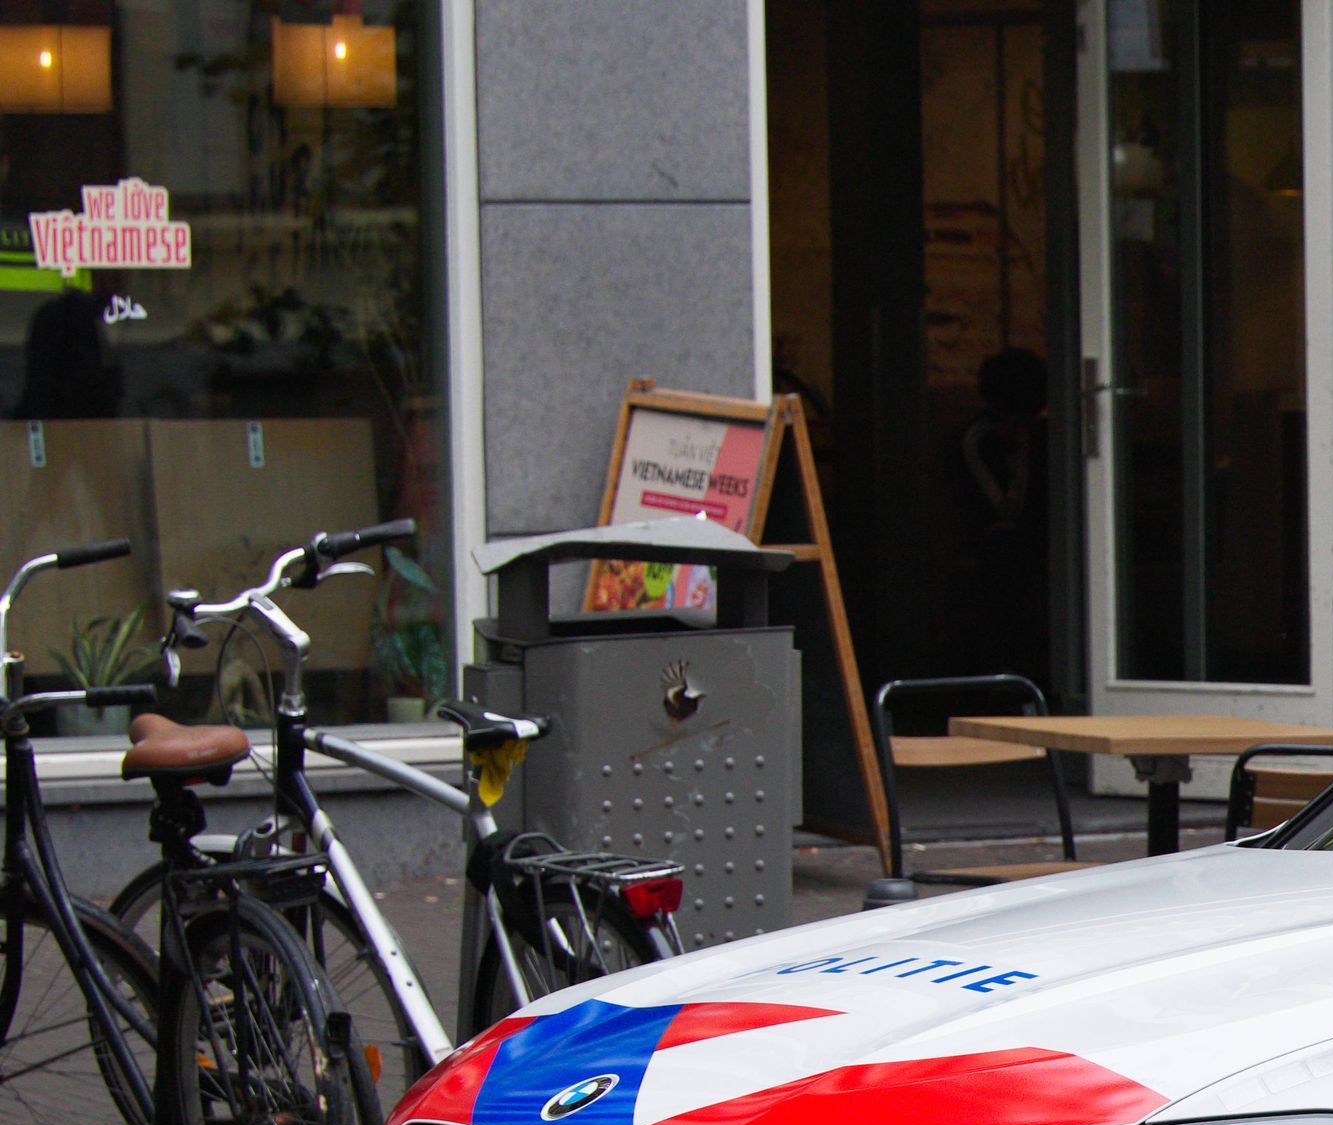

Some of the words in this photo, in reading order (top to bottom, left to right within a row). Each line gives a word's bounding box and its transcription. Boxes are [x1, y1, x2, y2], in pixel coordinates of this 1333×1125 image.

[87, 190, 116, 222] we
[632, 459, 707, 490] VIETNAMESE
[708, 472, 749, 498] WEEKS
